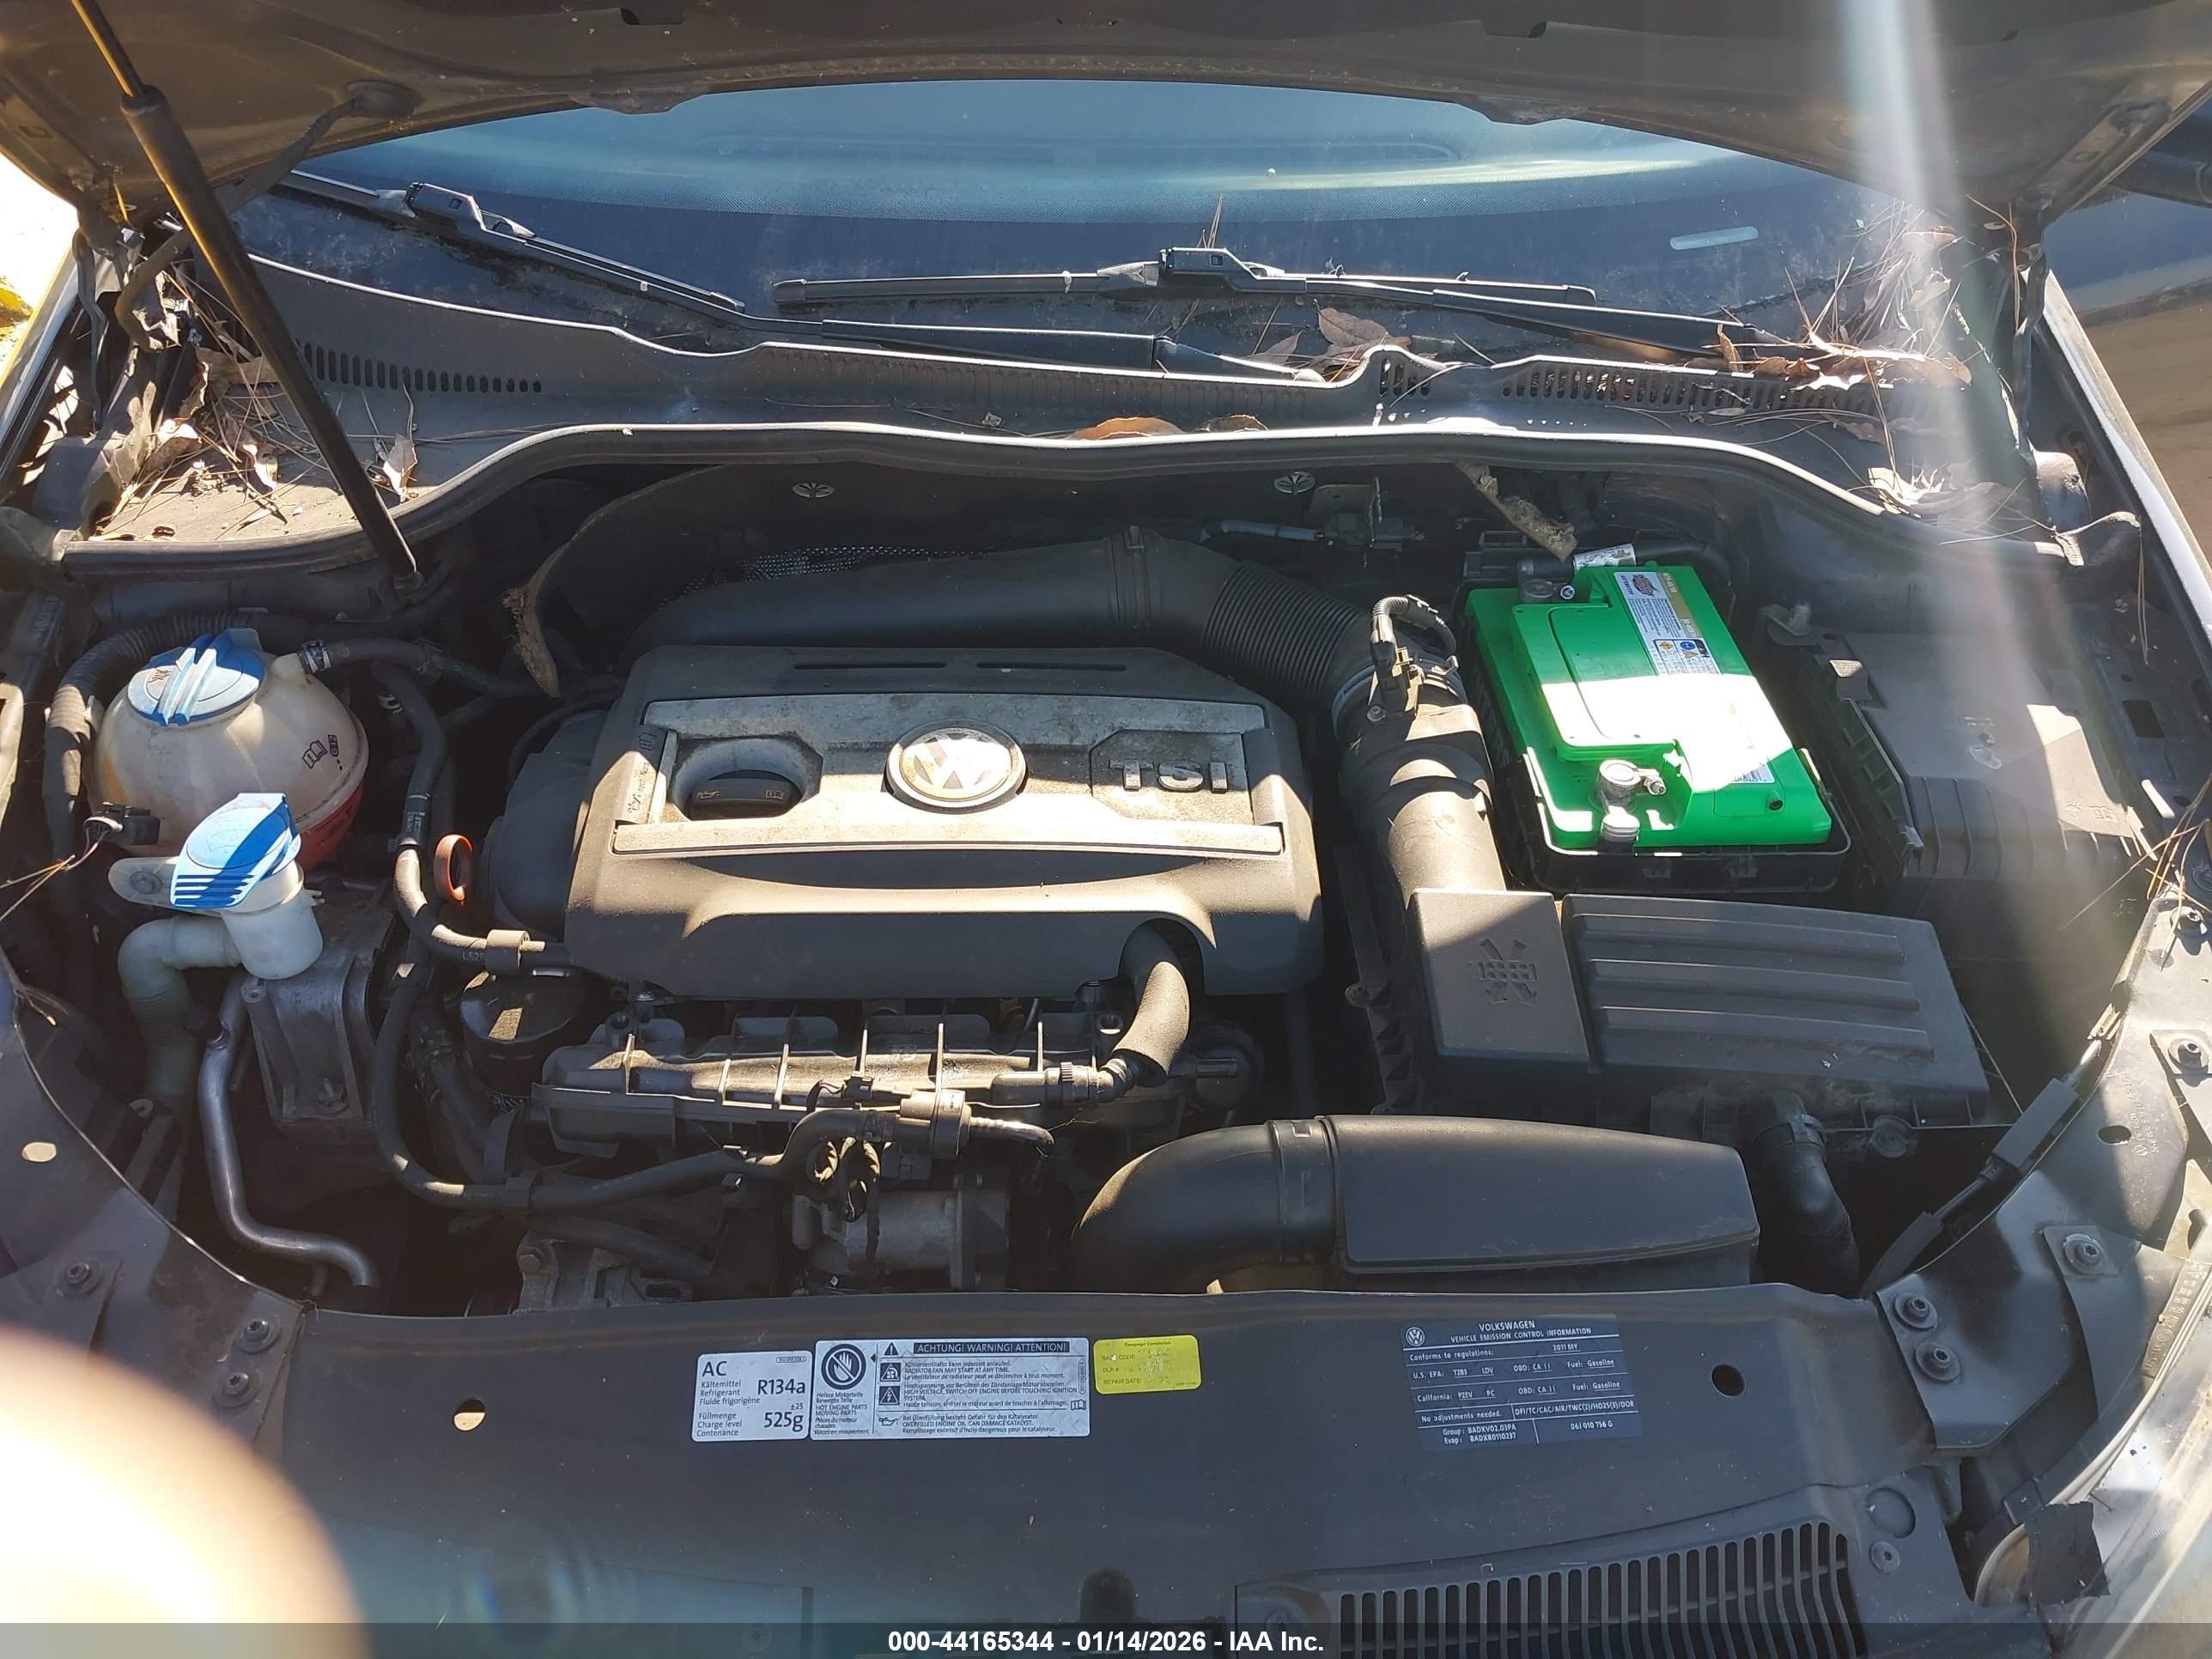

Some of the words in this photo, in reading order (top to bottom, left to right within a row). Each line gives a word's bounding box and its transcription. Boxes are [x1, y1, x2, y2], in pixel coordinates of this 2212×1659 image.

[1479, 1320, 1535, 1332] VOLKSWAGEN
[1480, 1332, 1511, 1341] EMISSION
[1514, 1330, 1544, 1339] CONTROL
[1547, 1327, 1591, 1337] INFORMATION
[917, 1343, 963, 1352] ACHTUNG!
[967, 1342, 1012, 1352] WARNING!
[1015, 1342, 1066, 1352] ATTENTION!
[1454, 1348, 1494, 1358] regulations:
[1587, 1358, 1615, 1367] Gasoline
[702, 1361, 727, 1377] AC
[701, 1380, 741, 1389] Kältemittel
[757, 1378, 805, 1395] R134a
[1592, 1381, 1620, 1389] Gasoline
[700, 1389, 740, 1398] Refrigerant
[722, 1397, 761, 1407] frigorigène
[699, 1412, 737, 1421] Füllmenge
[1433, 1412, 1474, 1422] adjustments
[763, 1412, 804, 1432] 525g
[1607, 1419, 1613, 1428] G
[696, 1429, 738, 1437] Contenance
